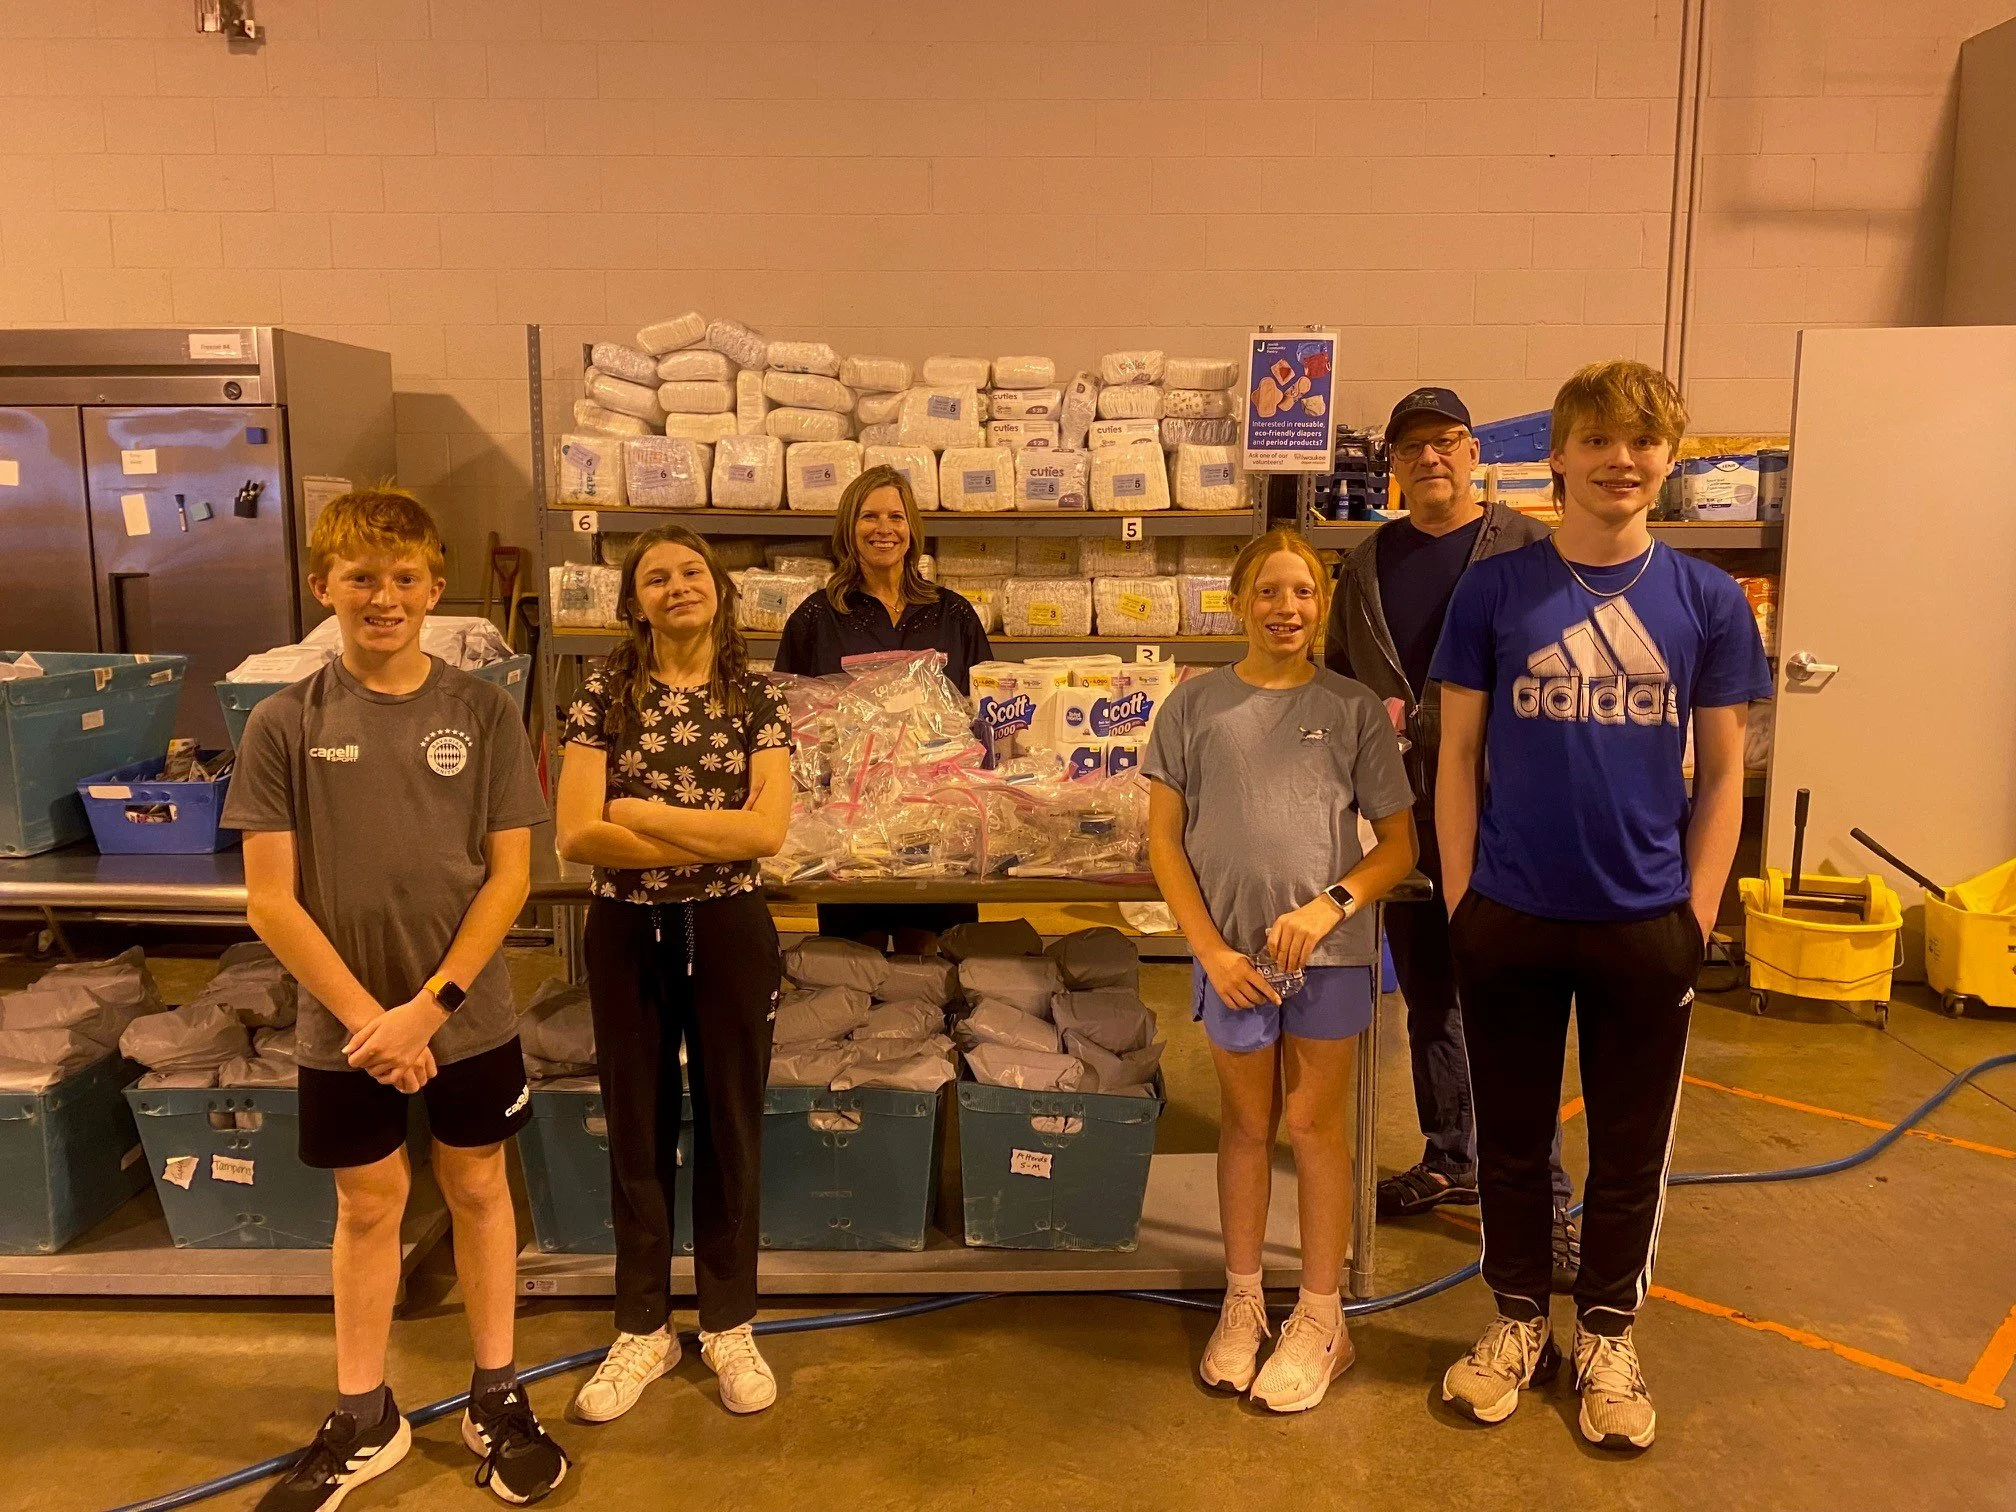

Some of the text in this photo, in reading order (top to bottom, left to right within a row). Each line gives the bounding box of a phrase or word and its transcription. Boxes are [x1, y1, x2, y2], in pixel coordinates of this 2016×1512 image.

[992, 392, 1018, 400] cuties
[950, 404, 956, 412] 5
[993, 424, 1019, 432] cuties
[1096, 426, 1122, 434] cuties
[660, 471, 667, 479] 6
[747, 471, 753, 479] 6
[824, 471, 831, 479] 6
[1030, 466, 1065, 477] cuties
[1222, 470, 1229, 478] 5
[585, 469, 597, 497] aby
[985, 477, 991, 485] 5
[1134, 480, 1141, 488] 5
[1048, 484, 1054, 492] 5
[579, 515, 591, 530] 6
[1127, 522, 1137, 537] 5
[1125, 541, 1131, 549] 3
[1060, 552, 1066, 560] 3
[1139, 604, 1146, 612] 3
[1513, 669, 1679, 727] adidas
[986, 694, 1028, 725] Scott
[1110, 692, 1144, 722] cott
[994, 725, 1016, 740] 1000
[431, 738, 463, 750] BAVARIAN
[309, 745, 359, 761] capelli
[435, 766, 461, 776] UNITED
[1017, 1153, 1047, 1162] Attends
[213, 1161, 251, 1175] Tampons
